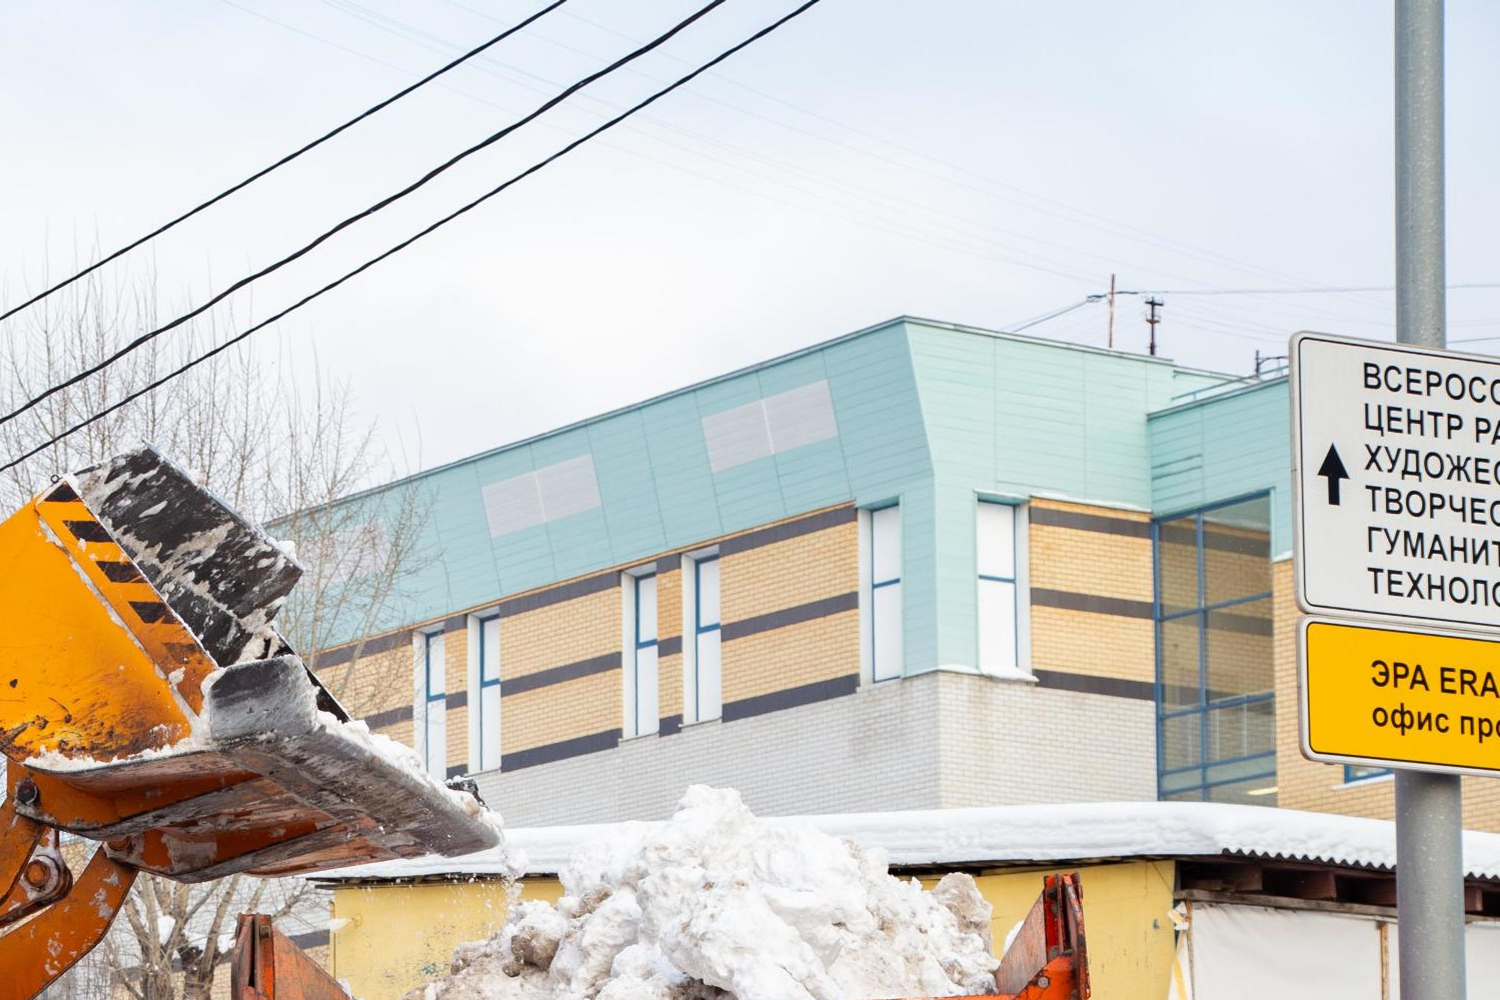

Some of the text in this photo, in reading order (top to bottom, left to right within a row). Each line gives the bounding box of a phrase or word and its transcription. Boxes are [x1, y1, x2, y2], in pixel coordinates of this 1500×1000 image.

[1365, 403, 1463, 440] ЦЕНТР
[1371, 660, 1429, 692] ЭРА
[1372, 703, 1500, 744] офис пр
